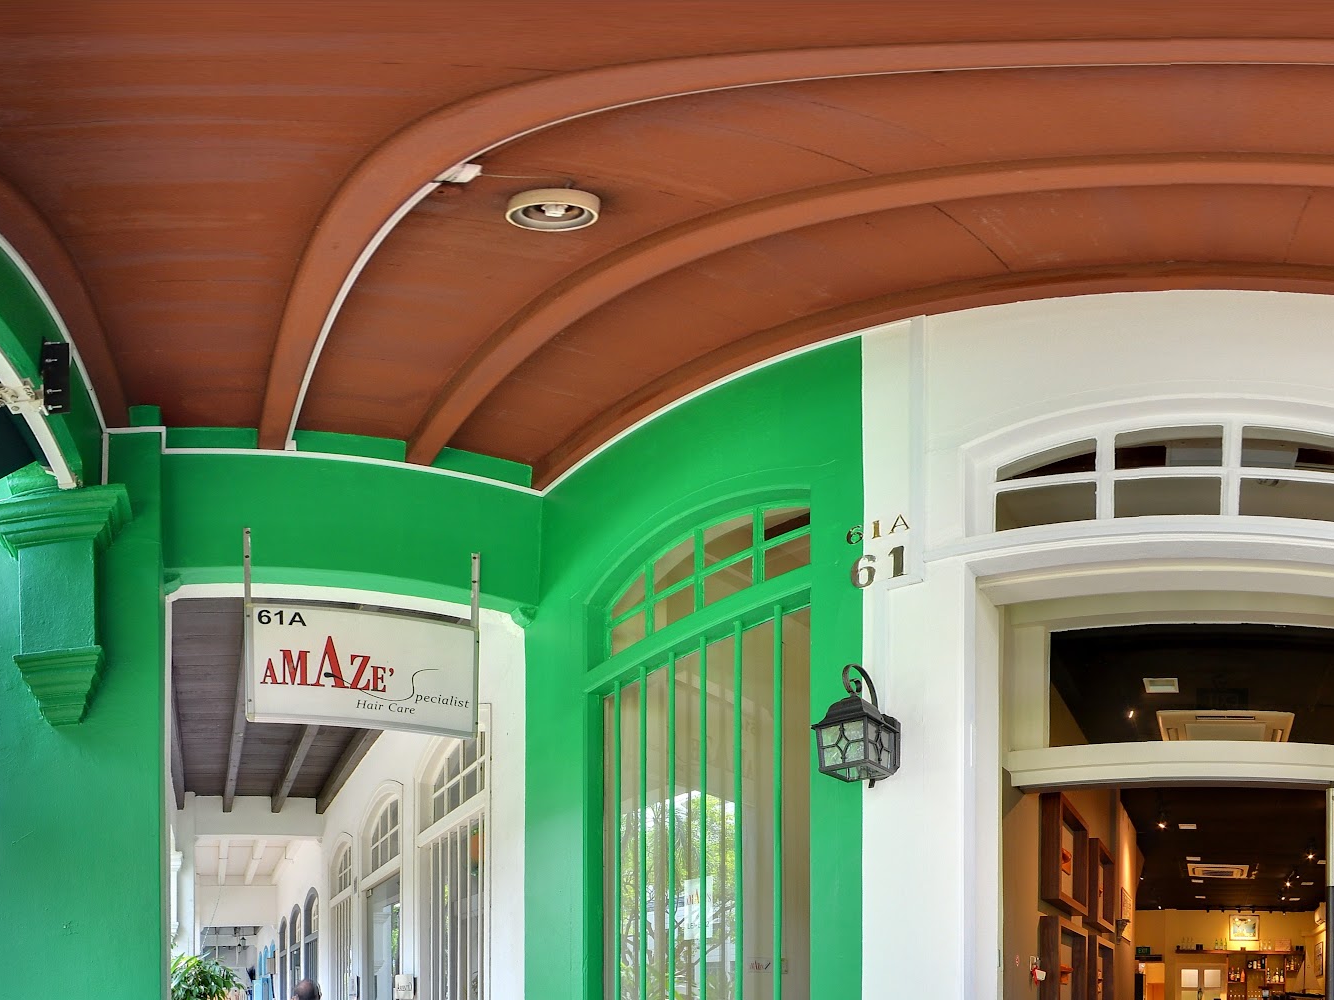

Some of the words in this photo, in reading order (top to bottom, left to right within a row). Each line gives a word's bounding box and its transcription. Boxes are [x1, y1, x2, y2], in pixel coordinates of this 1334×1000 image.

[846, 514, 909, 545] 61A
[851, 545, 907, 588] 61
[257, 609, 307, 627] 61A
[356, 699, 384, 711] Hair
[388, 702, 416, 715] Care
[409, 668, 470, 709] Specialist
